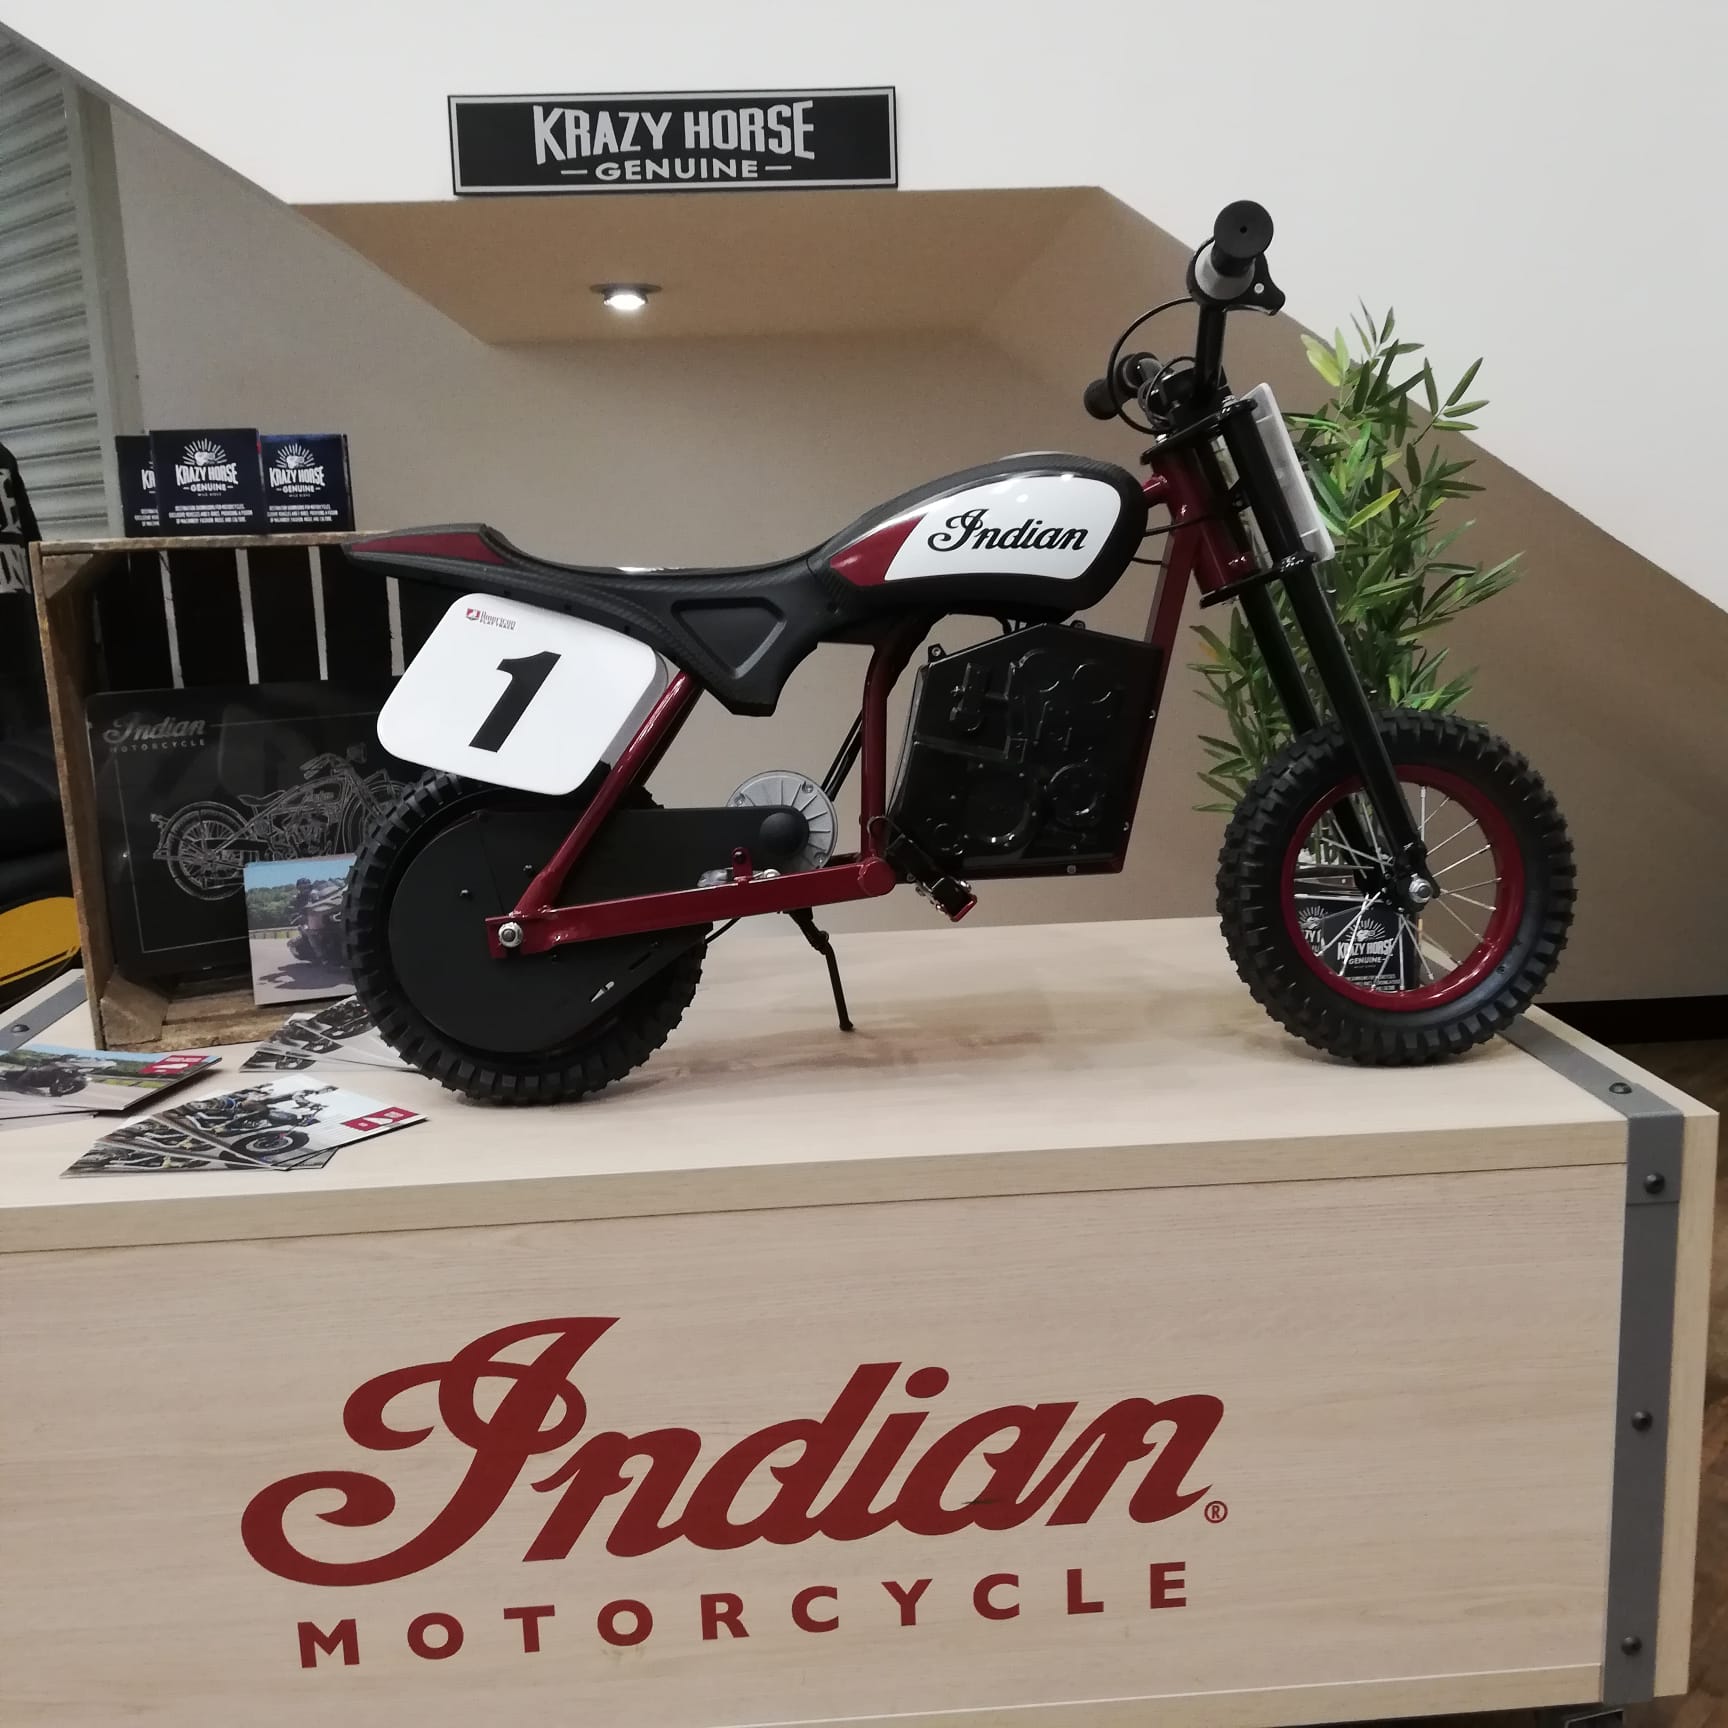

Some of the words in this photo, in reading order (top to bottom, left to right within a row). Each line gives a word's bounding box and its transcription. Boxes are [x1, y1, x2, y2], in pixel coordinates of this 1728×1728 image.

[532, 104, 673, 166] KRAZY
[684, 99, 815, 160] HORSE
[595, 157, 759, 181] GENUINE
[175, 464, 207, 486] KRAZY
[208, 462, 238, 484] HORSE
[269, 467, 297, 488] KRAZY
[298, 466, 325, 487] HORSE
[190, 483, 227, 492] GENUINE
[282, 485, 315, 493] GENUINE
[927, 508, 1088, 552] Indian
[468, 651, 562, 753] 1
[103, 712, 206, 743] Indian
[110, 739, 206, 753] MOTORCYCLE
[1348, 957, 1382, 965] GENUINE
[242, 1317, 1224, 1586] Indian
[298, 1562, 1188, 1668] MOTORCYCLE
